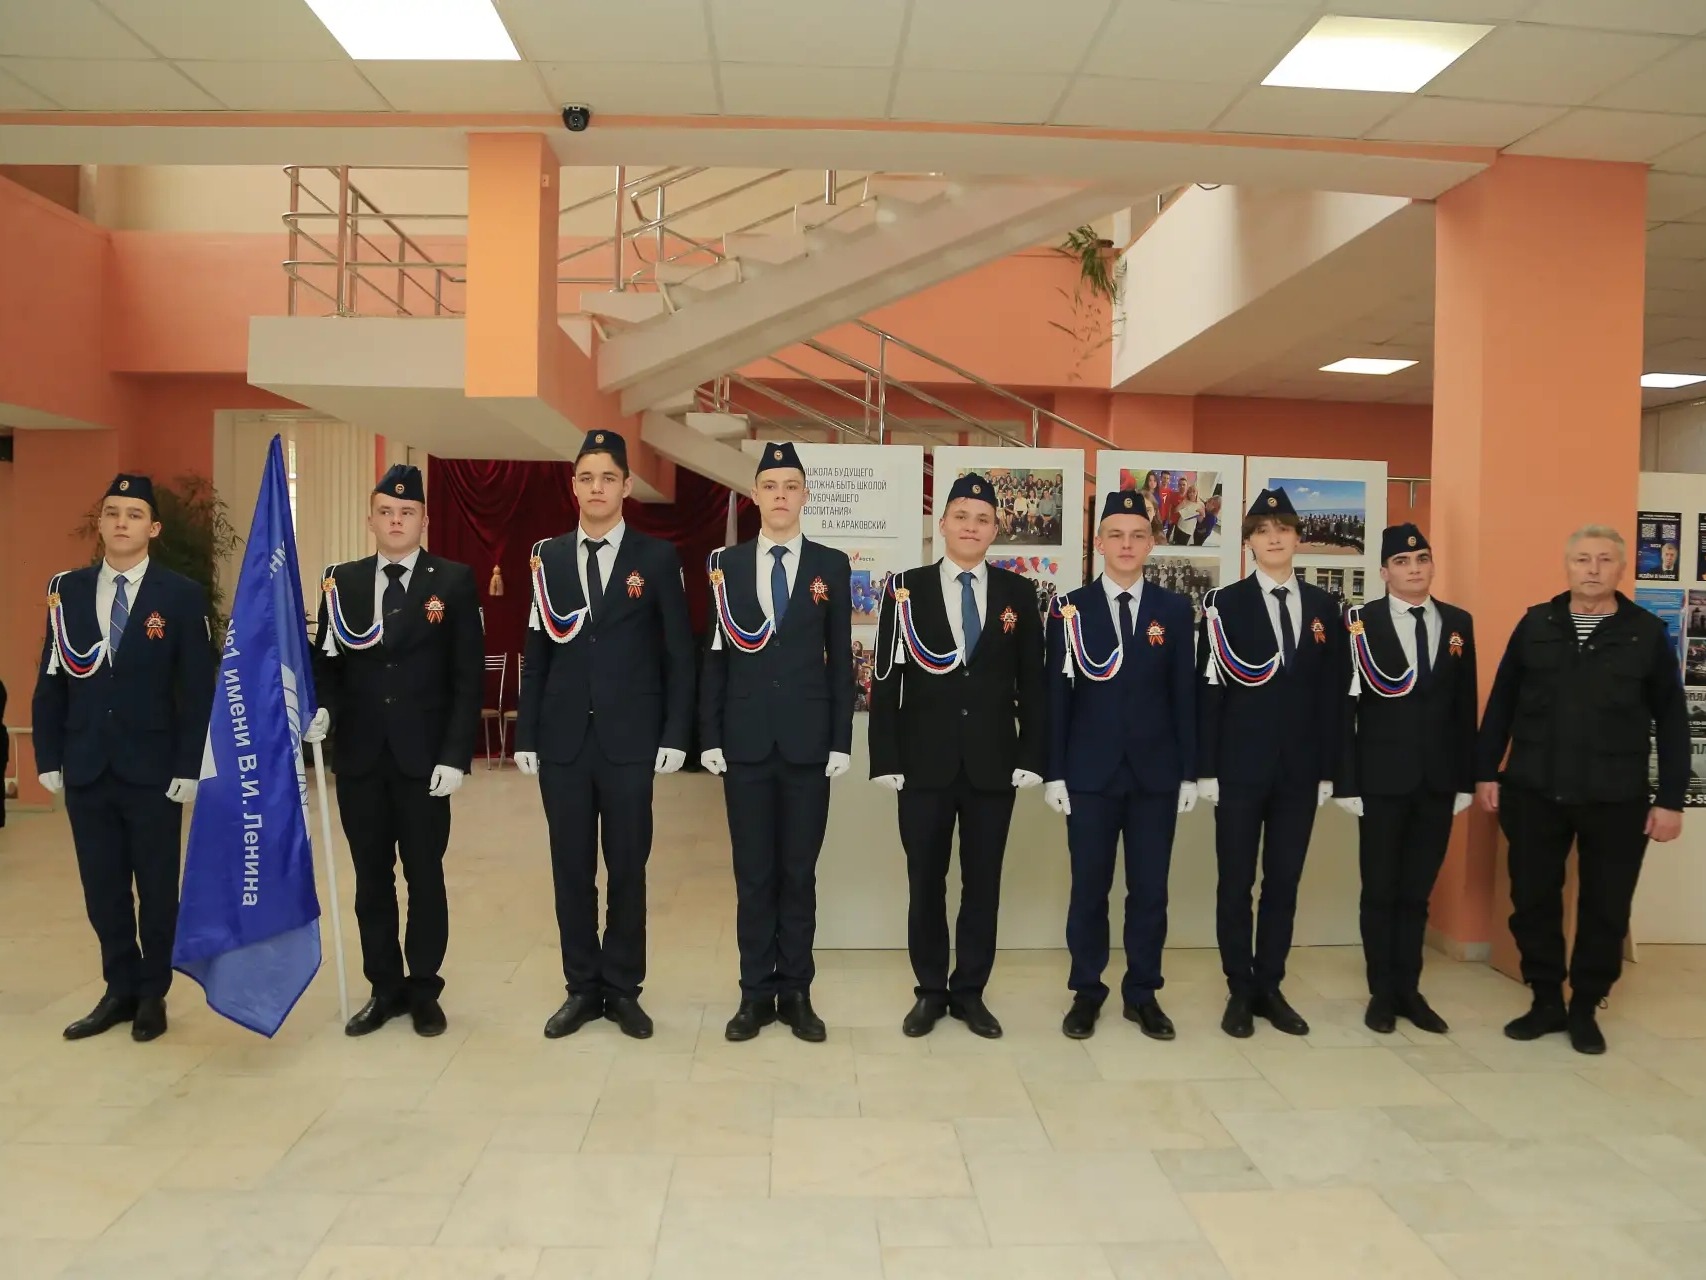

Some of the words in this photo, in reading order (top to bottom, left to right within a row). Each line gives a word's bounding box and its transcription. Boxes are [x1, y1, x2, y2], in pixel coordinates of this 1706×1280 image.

[834, 468, 874, 478] БУДУЩЕГО
[836, 481, 856, 490] БЫТЬ
[857, 480, 887, 490] ШКОЛОЙ
[807, 493, 859, 503] ЛУБОЧАЙШЕГО
[836, 520, 887, 530] КАРАКОВСКИЙ
[223, 668, 251, 748] имени
[237, 753, 261, 805] В.И.
[242, 812, 263, 907] Ленина
